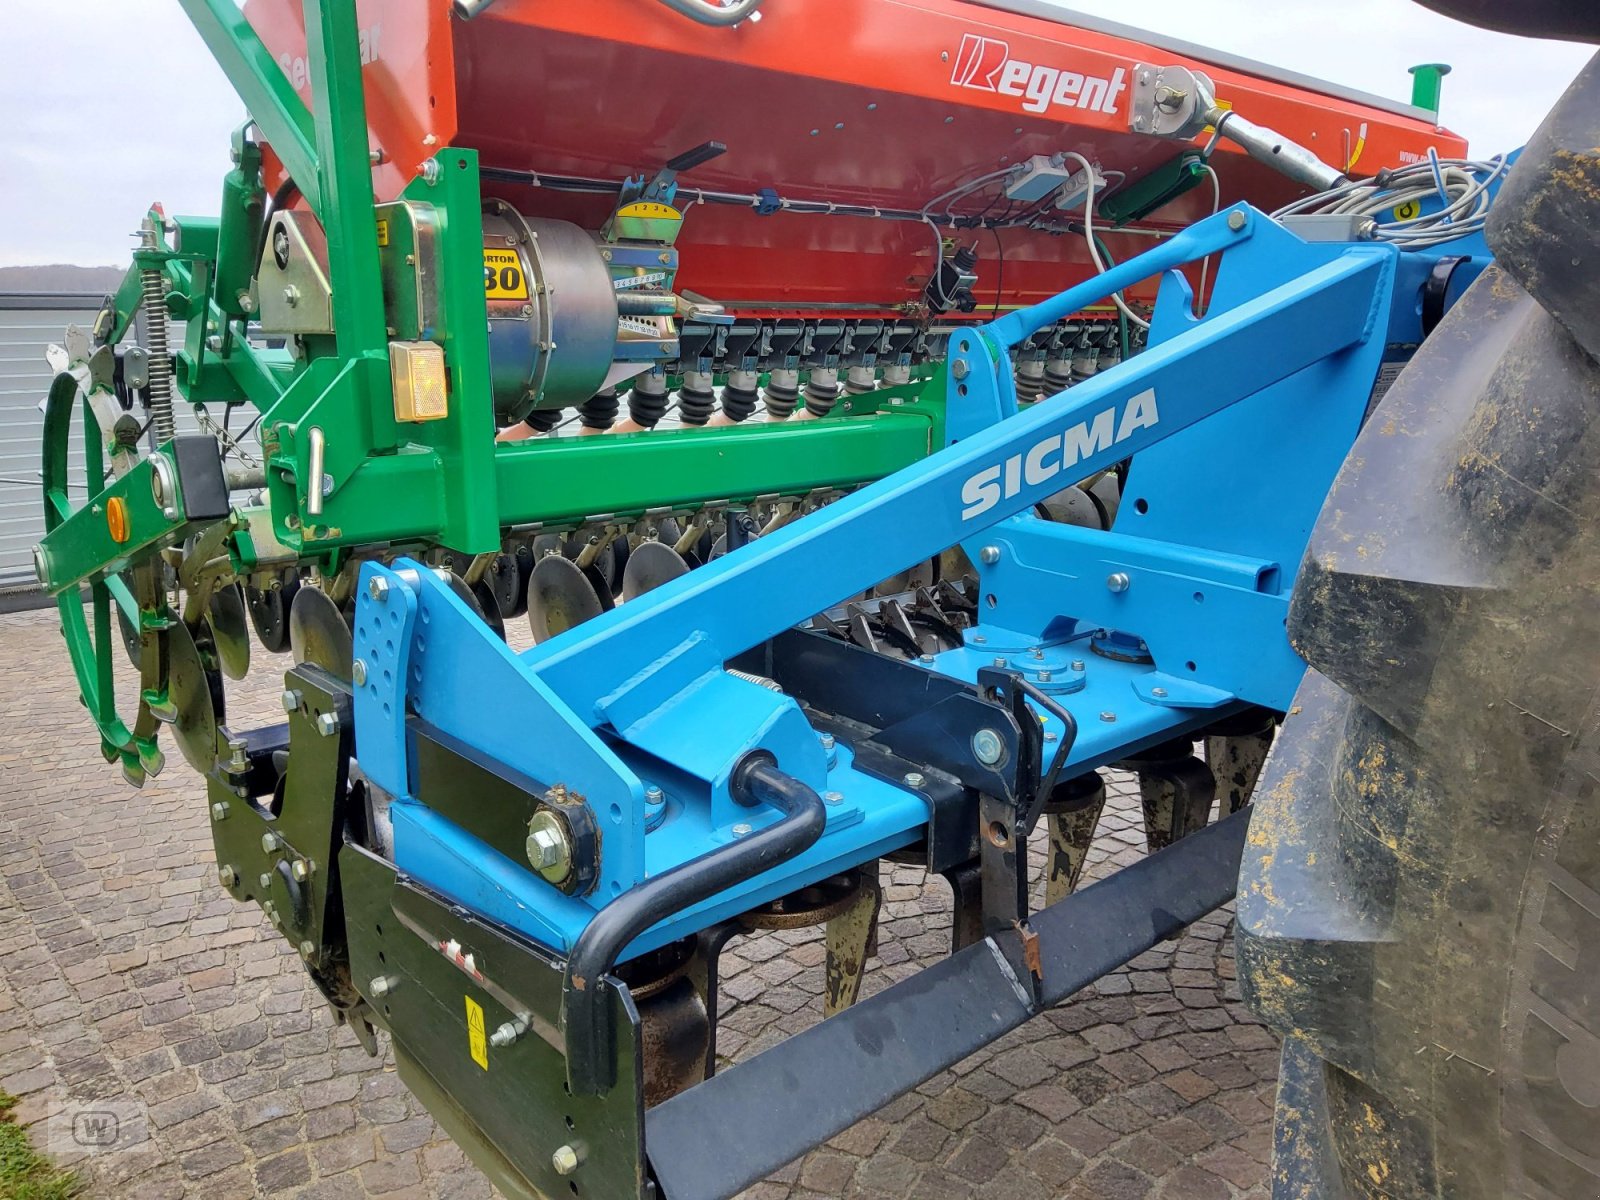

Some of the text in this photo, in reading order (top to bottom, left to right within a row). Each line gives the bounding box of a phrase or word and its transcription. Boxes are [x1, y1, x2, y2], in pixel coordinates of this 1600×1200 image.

[950, 33, 1126, 113] Regent
[484, 255, 514, 263] RTON
[961, 387, 1159, 521] SICMA
